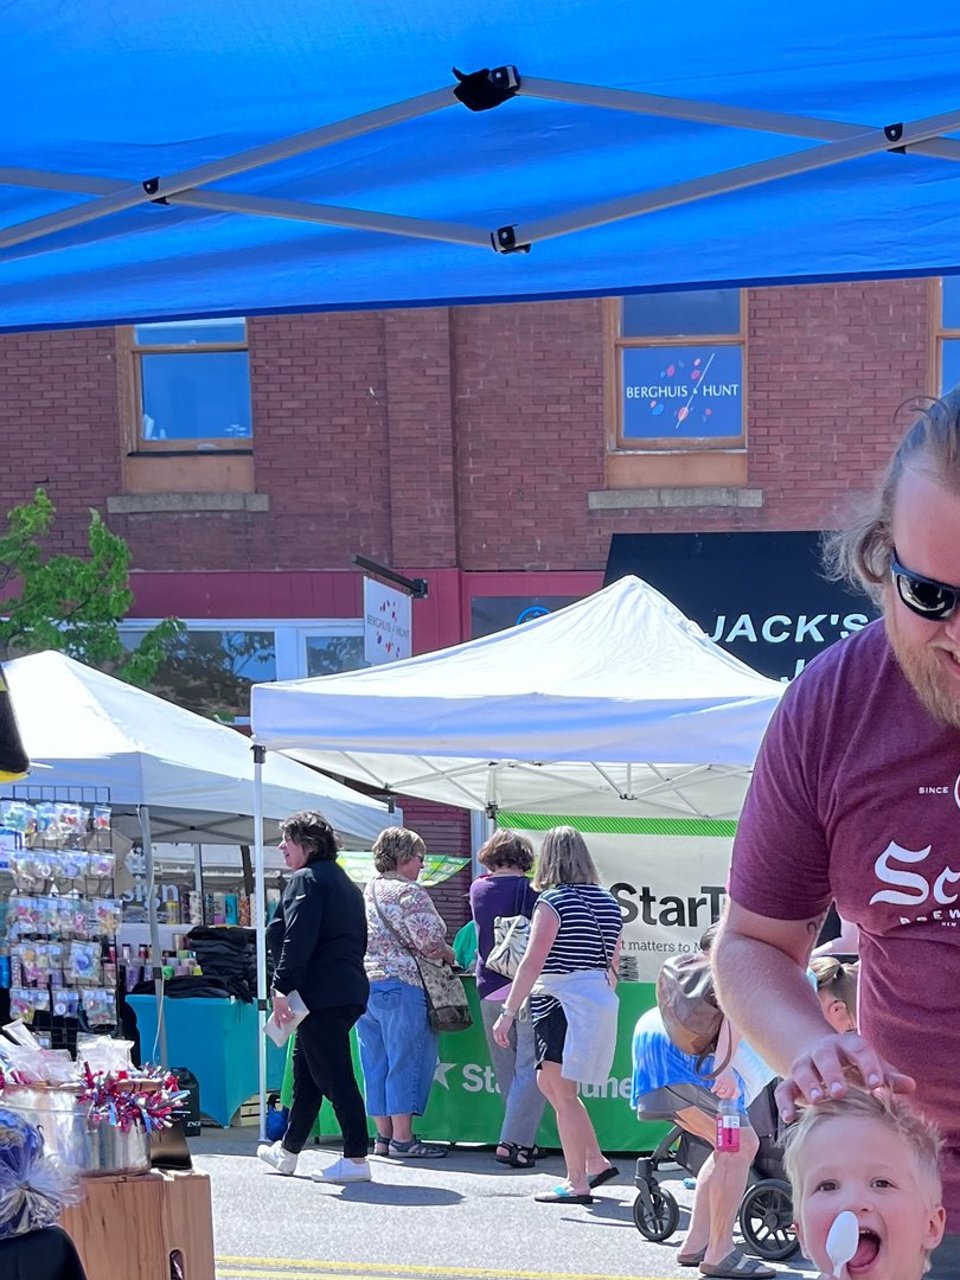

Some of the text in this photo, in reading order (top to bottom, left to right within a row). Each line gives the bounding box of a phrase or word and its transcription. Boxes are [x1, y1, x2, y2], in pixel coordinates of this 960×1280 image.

[626, 385, 688, 399] BERGHUIS
[703, 383, 739, 397] HUNT
[704, 613, 869, 644] JACK'S
[918, 786, 949, 795] SINCE
[628, 941, 677, 953] matters
[678, 941, 691, 953] to
